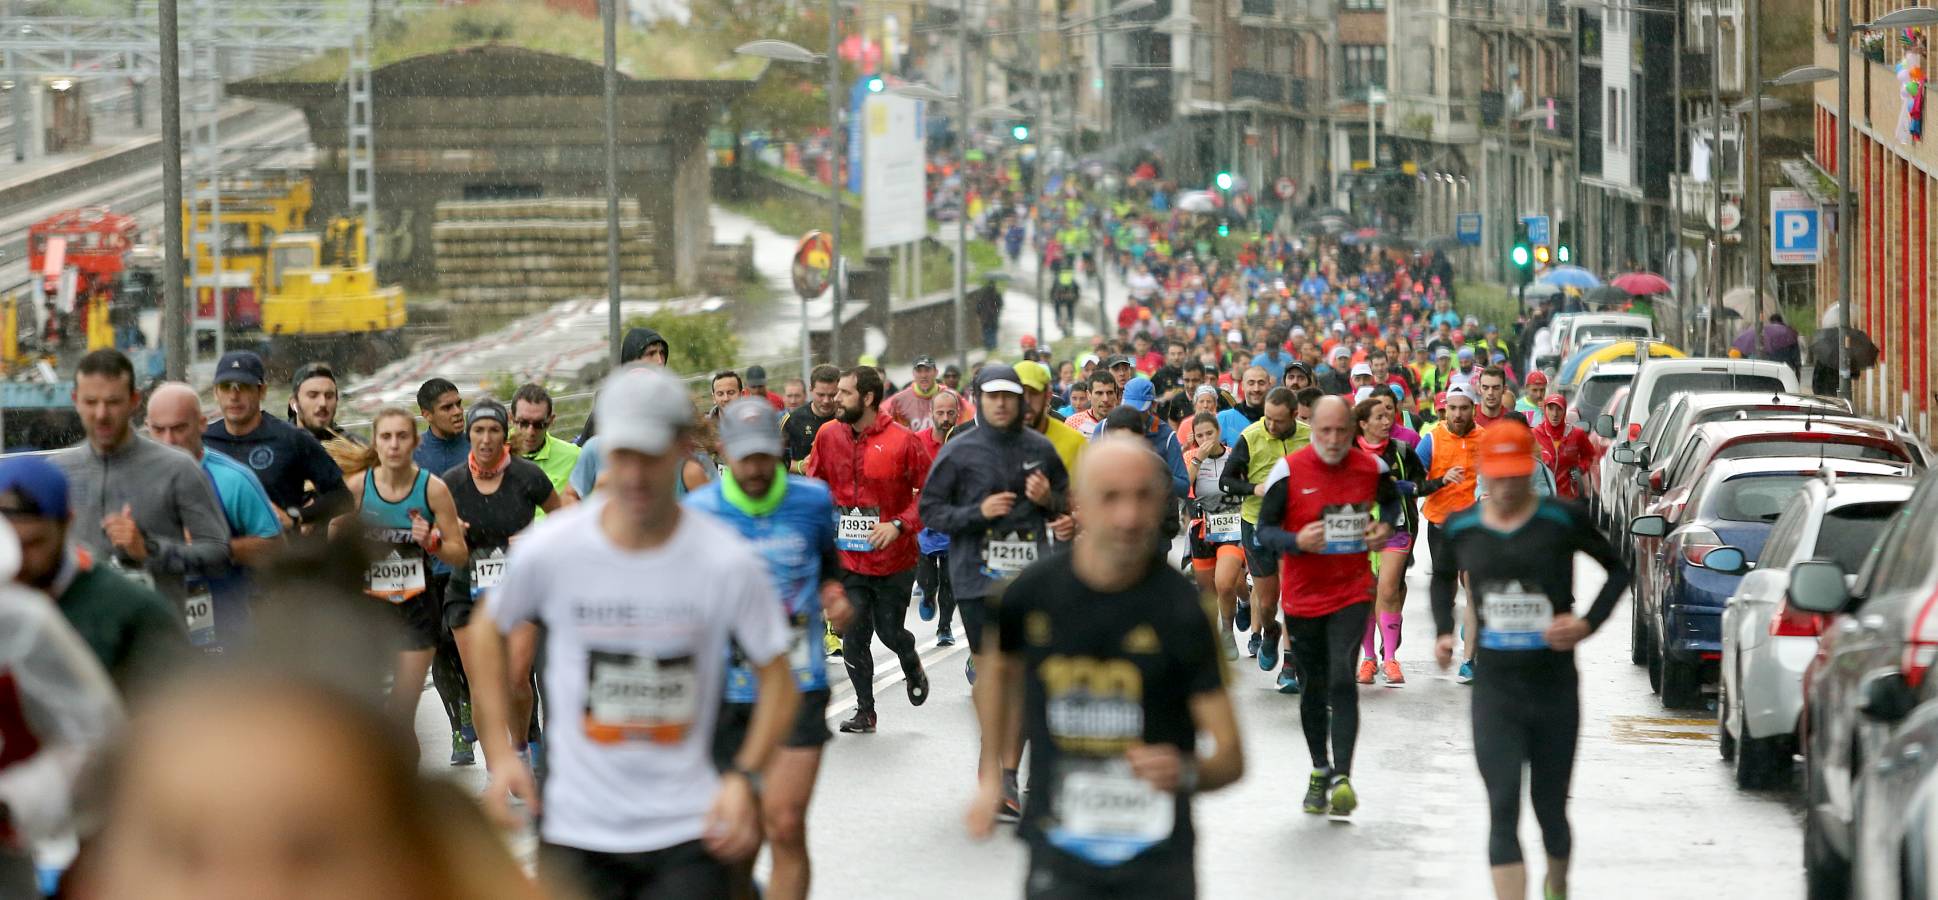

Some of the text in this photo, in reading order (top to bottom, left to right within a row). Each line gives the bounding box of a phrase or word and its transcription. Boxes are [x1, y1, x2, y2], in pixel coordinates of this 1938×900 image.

[1783, 214, 1809, 248] P
[841, 519, 875, 531] 13932
[1212, 516, 1240, 526] 16345
[992, 546, 1034, 561] 12116
[372, 563, 417, 578] 20901
[478, 562, 506, 578] 177
